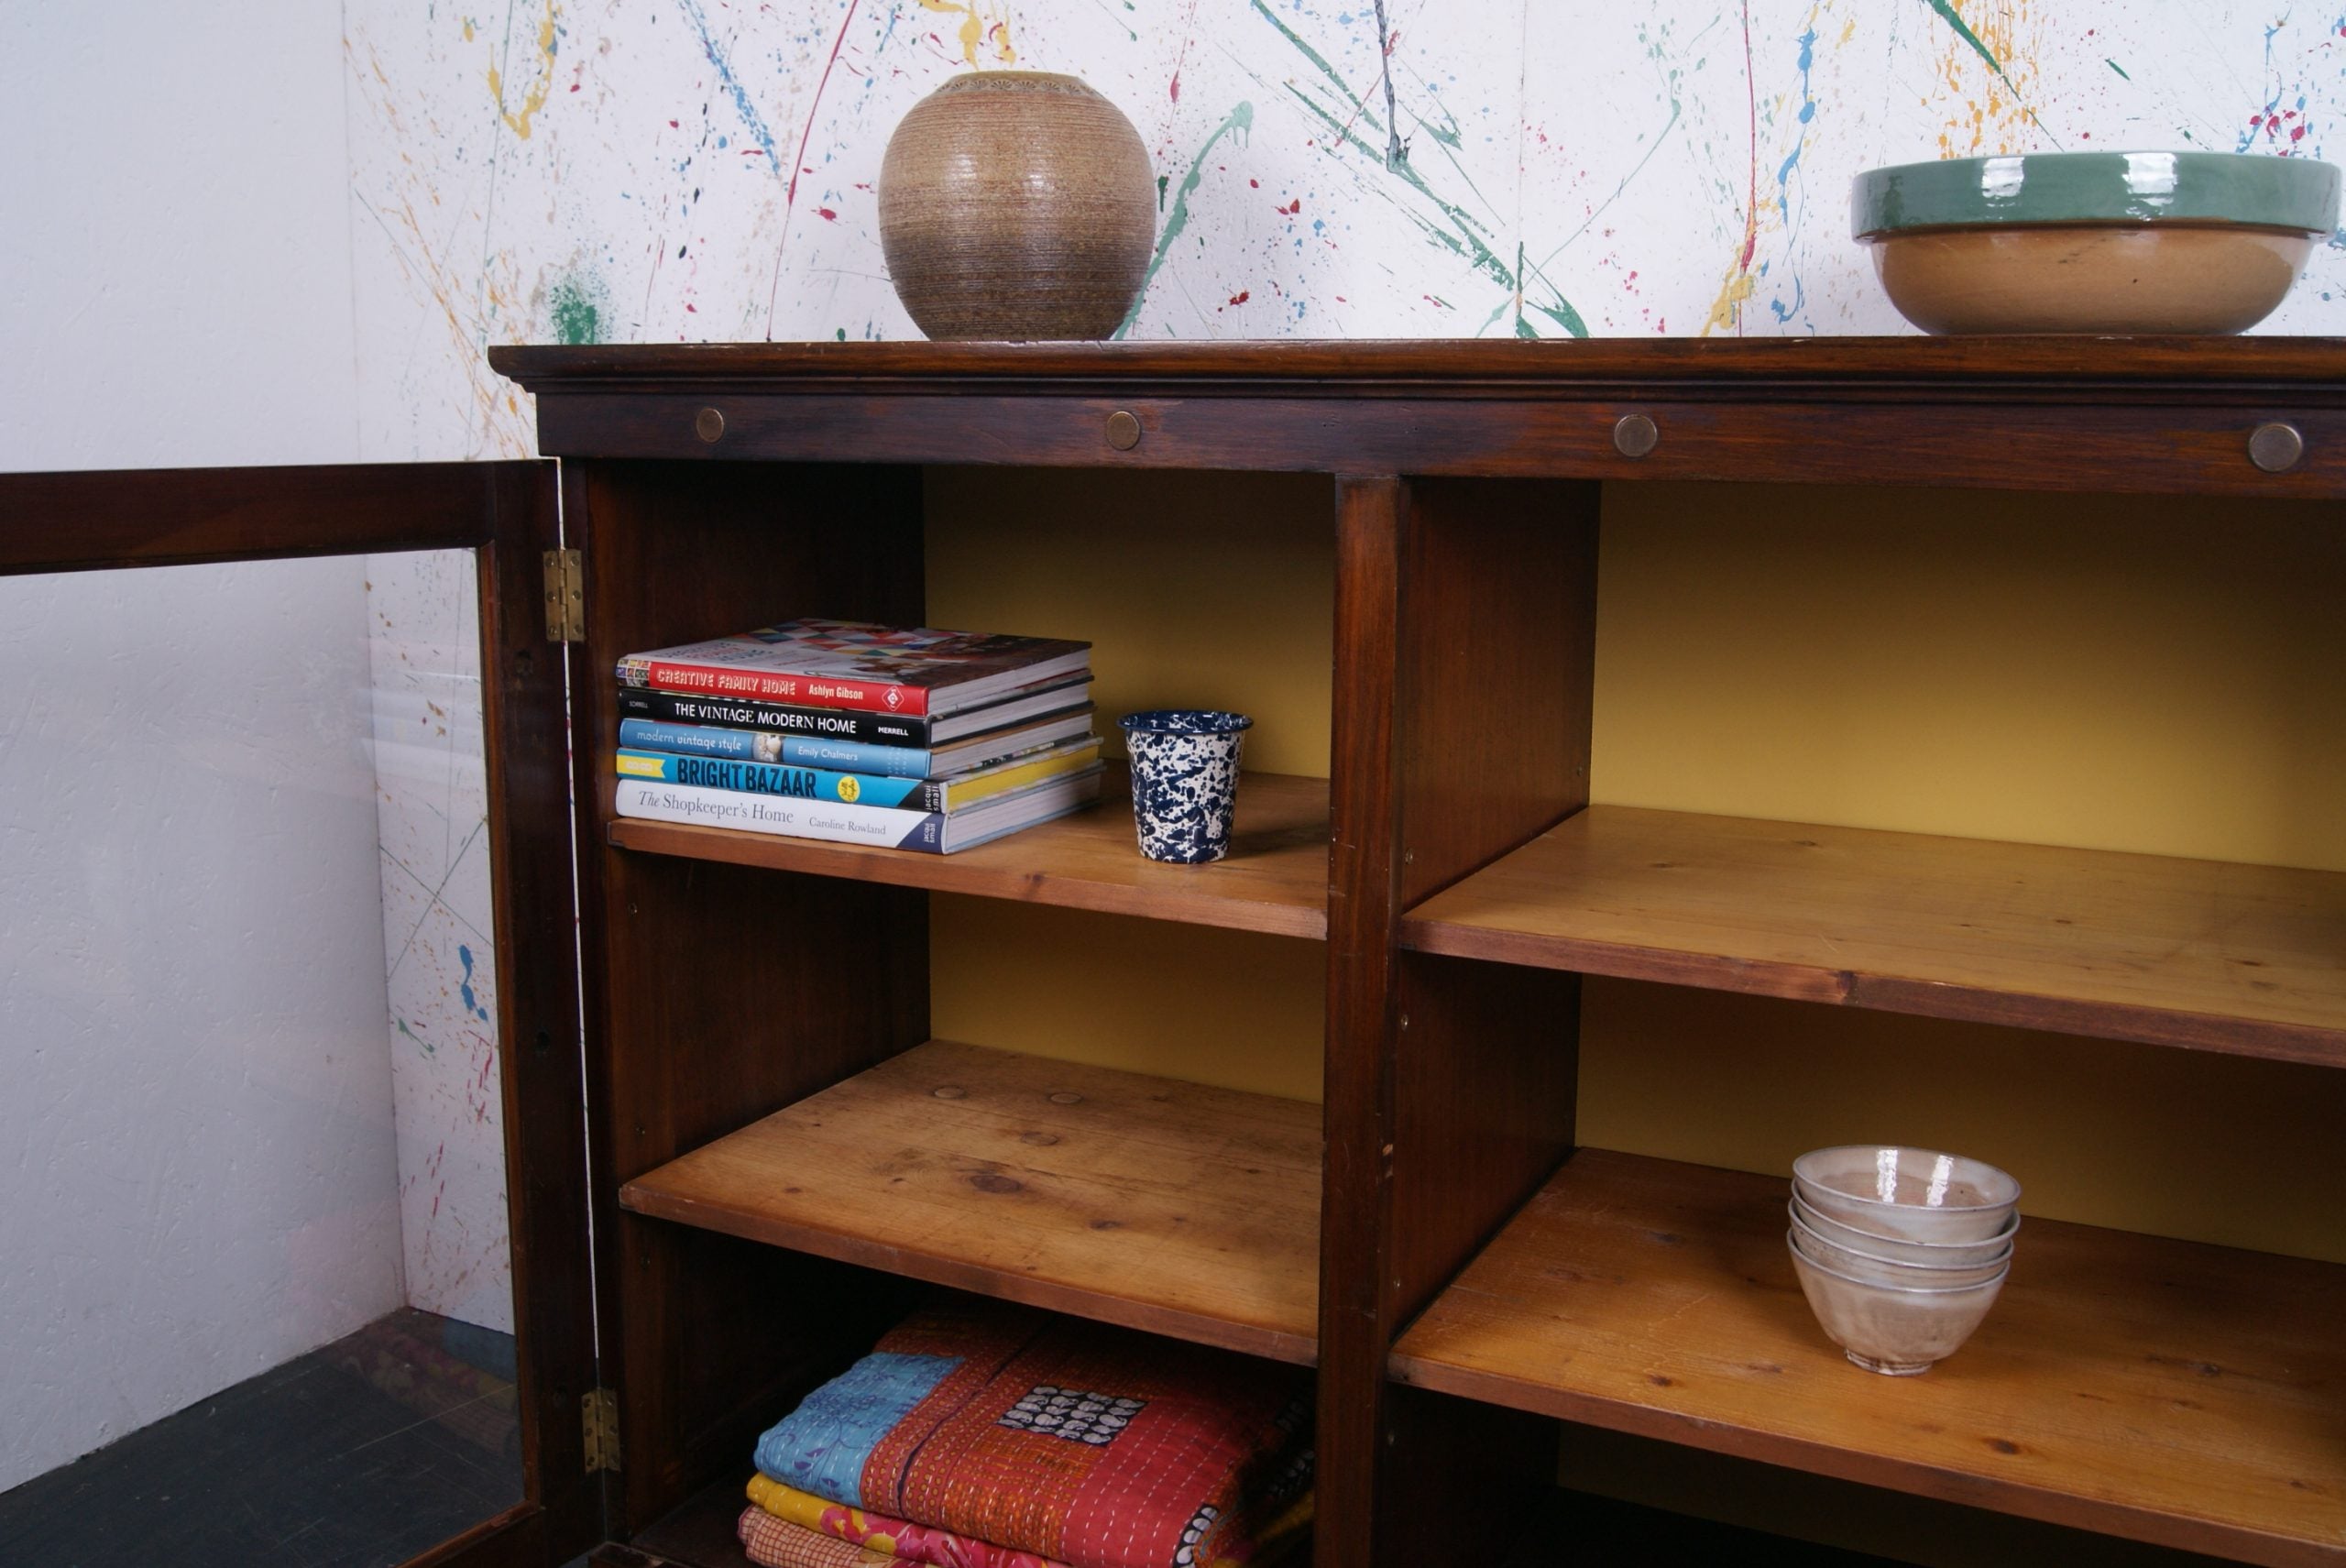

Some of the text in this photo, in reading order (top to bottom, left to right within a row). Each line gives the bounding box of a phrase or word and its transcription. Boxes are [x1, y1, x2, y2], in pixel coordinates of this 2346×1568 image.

[657, 668, 796, 696] CREATIVE FAMILY HOME
[808, 684, 863, 700] Ashlyn Gibson
[674, 702, 857, 734] THE VINTAGE MODERN HOME
[637, 728, 741, 753] modern vintage style
[878, 726, 909, 736] MERRELL
[797, 746, 859, 762] Emily Chalmers
[677, 758, 743, 790] BRIGHT
[745, 765, 817, 798] BAZAAR
[639, 791, 795, 823] The Shopkeeper's Home
[809, 817, 886, 835] Caroline Rowland
